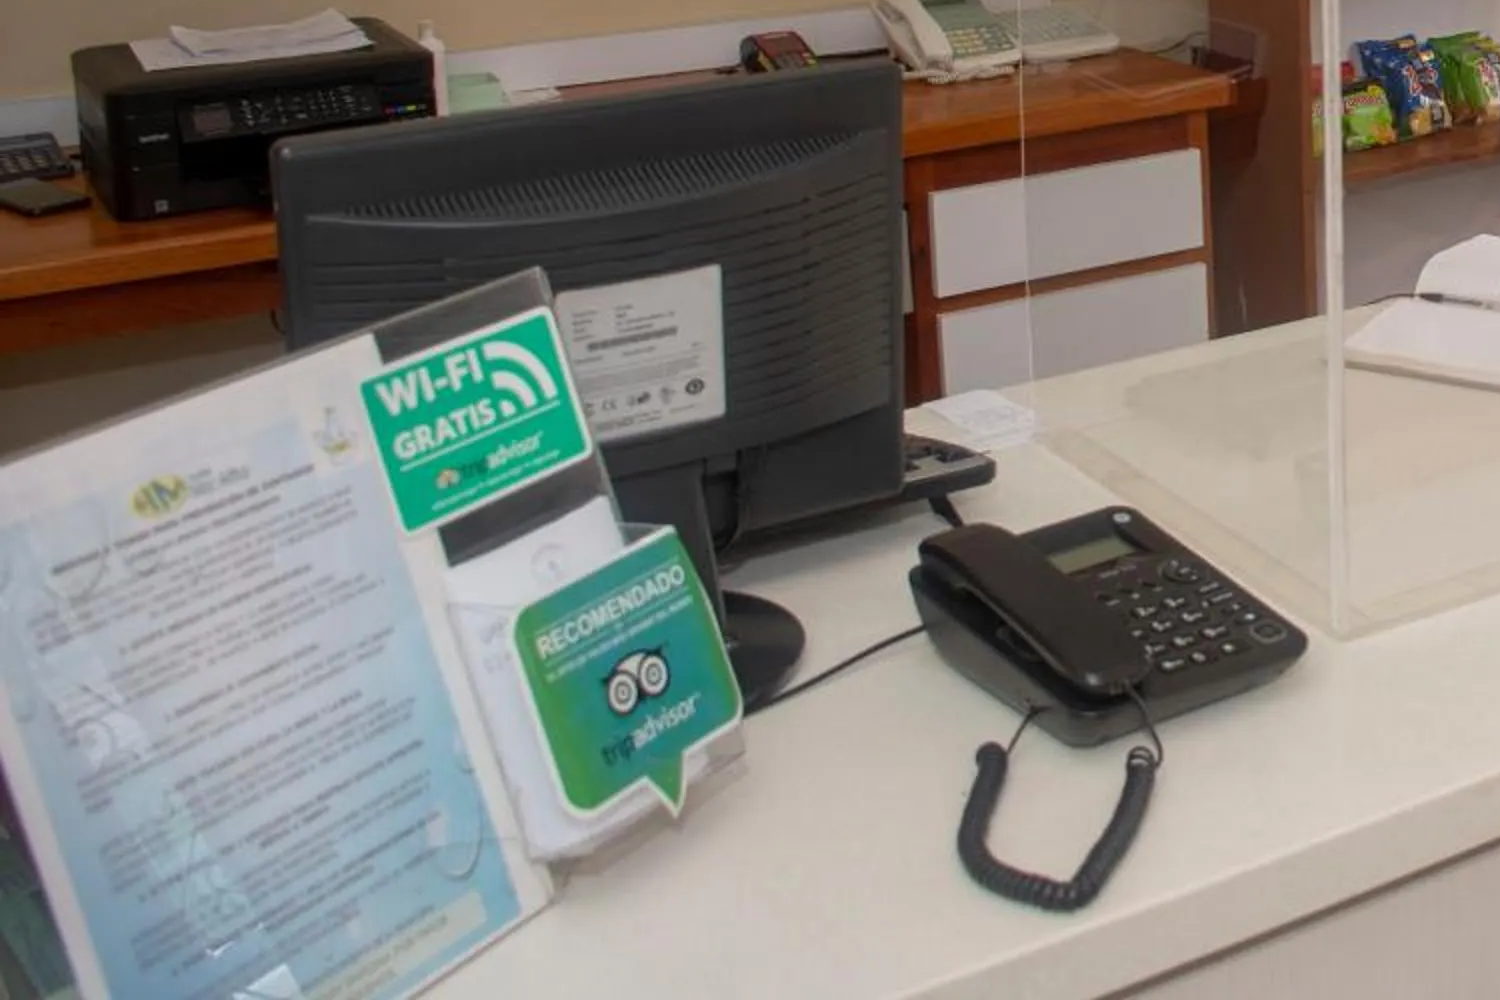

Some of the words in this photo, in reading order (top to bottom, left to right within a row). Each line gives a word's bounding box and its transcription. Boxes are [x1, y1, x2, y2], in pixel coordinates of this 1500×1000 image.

[375, 348, 484, 416] WI-FI
[393, 398, 497, 459] GRATIS
[536, 564, 686, 660] RECOMENDADO
[601, 697, 697, 766] tripadvisor
